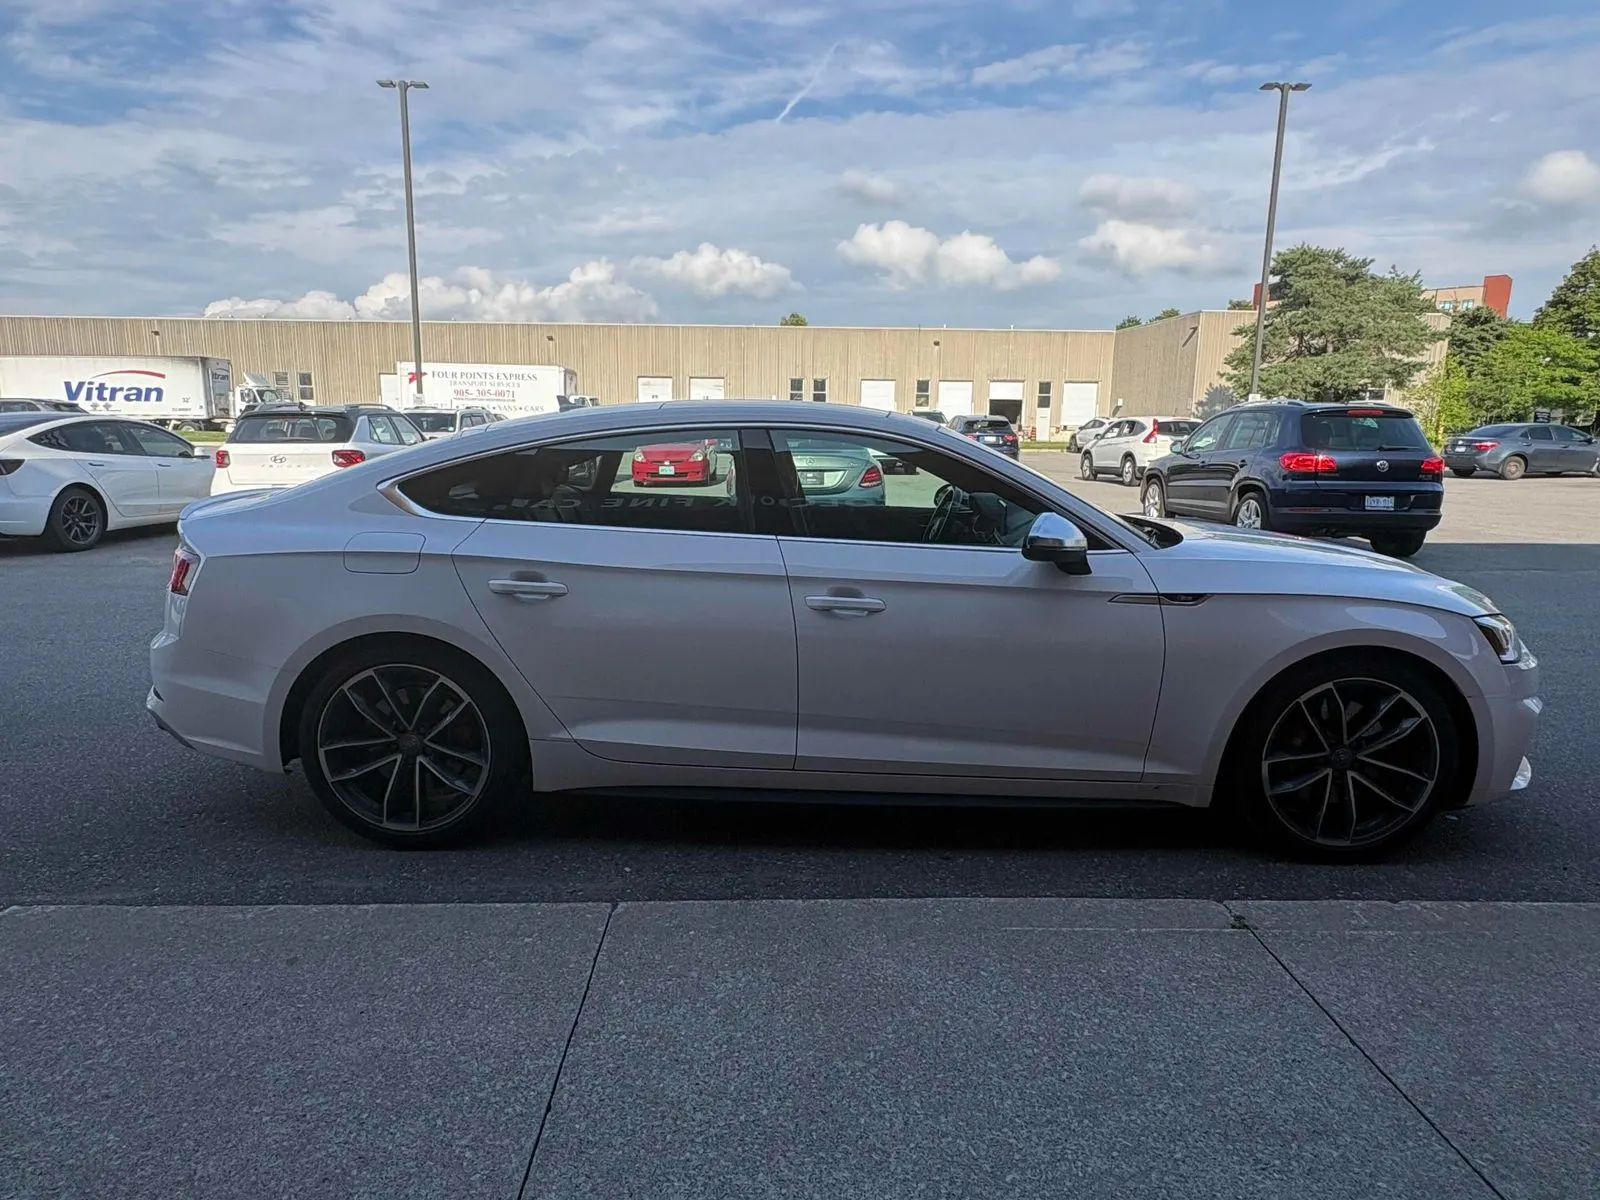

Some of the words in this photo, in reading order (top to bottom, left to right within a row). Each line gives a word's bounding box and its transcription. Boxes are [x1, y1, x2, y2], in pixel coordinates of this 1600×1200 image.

[432, 370, 458, 379] FOUR
[460, 371, 494, 380] POINTS
[496, 372, 538, 381] EXPRESS
[450, 380, 487, 388] TRANSPORT
[63, 381, 164, 402] Vitran
[453, 389, 473, 397] 905-
[476, 389, 515, 399] 305-0071
[497, 405, 522, 413] VANS
[524, 405, 545, 413] CARS
